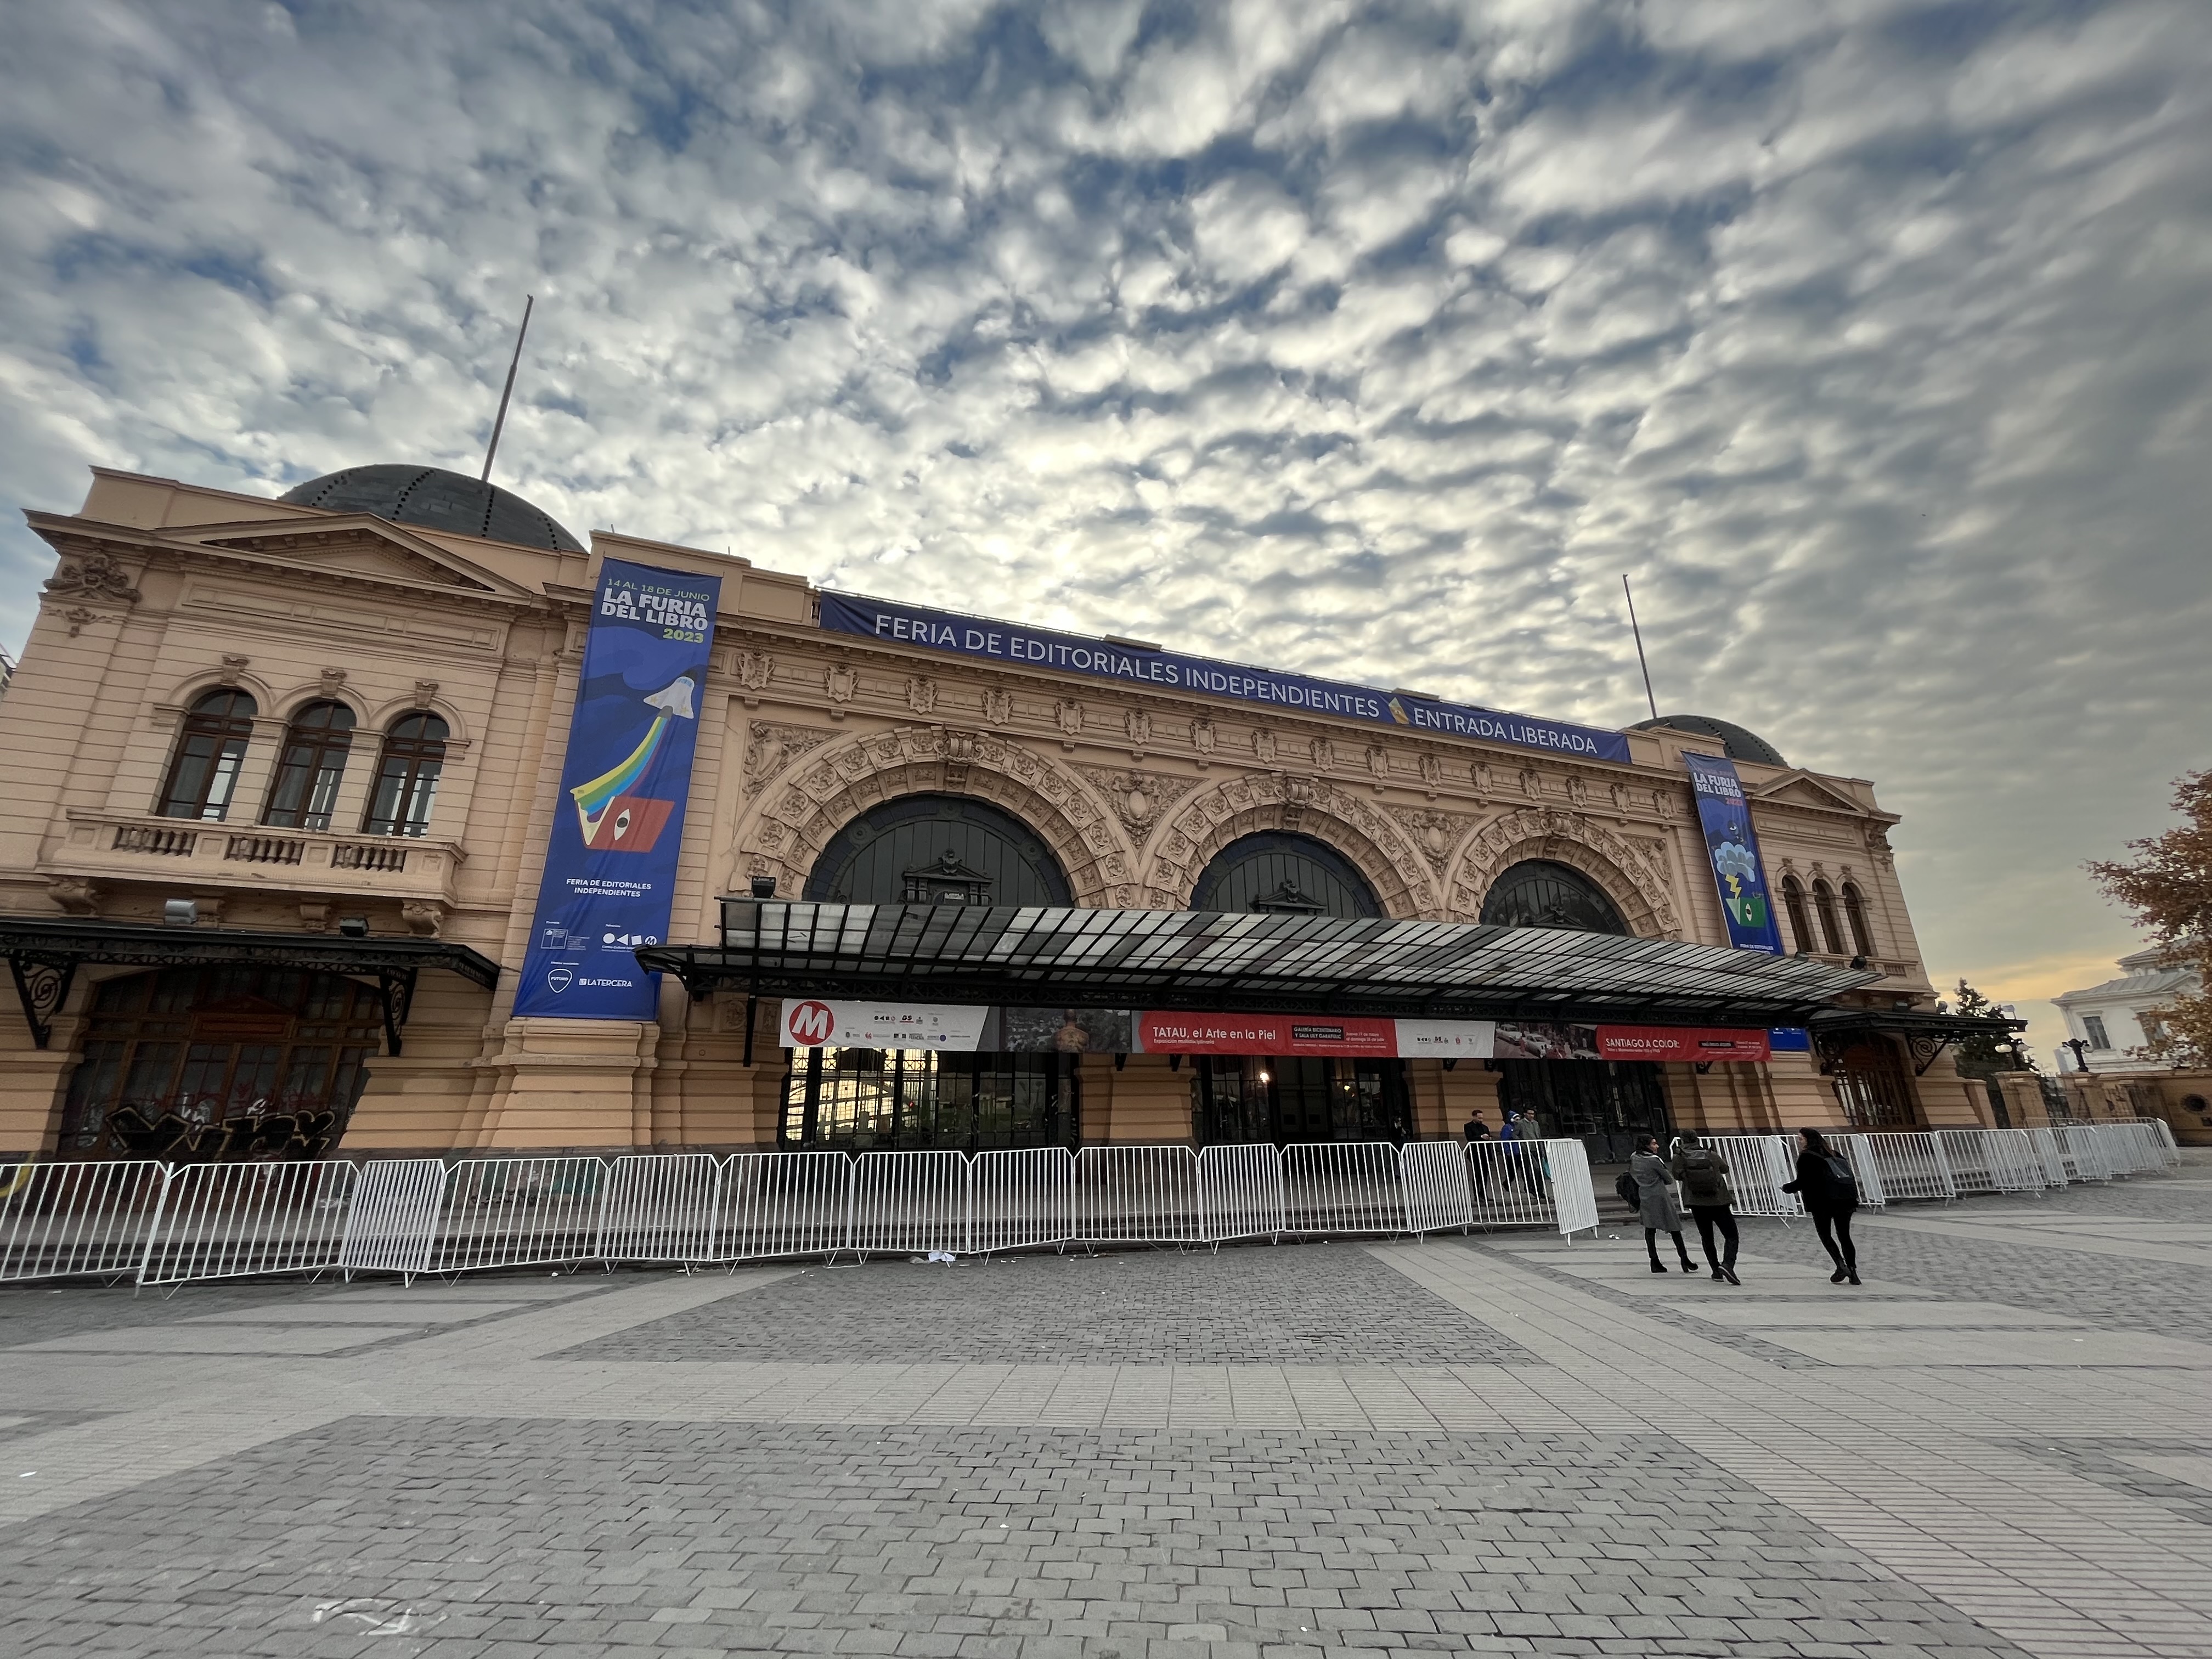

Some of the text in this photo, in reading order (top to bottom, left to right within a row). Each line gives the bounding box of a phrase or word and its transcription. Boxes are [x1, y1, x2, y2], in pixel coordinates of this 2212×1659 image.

[607, 578, 710, 602] 14 AL 18 DE JUNIO
[603, 588, 707, 618] LA FURIA
[601, 602, 708, 631] DEL LIBRO
[663, 628, 704, 644] 2023
[875, 614, 1598, 754] FERIA DE EDITORIALES INDEPENDIENTES ENTRADA LIBERADA
[1693, 772, 1708, 784] LA
[1707, 775, 1739, 789] FURIA
[1696, 783, 1741, 798] DEL LIBRO
[566, 878, 589, 887] FERIA
[601, 881, 652, 890] EDITORIALES
[574, 887, 641, 898] INDEPENDIENTES
[1153, 1026, 1276, 1040] TATAU, el Arte en la Piel
[1606, 1038, 1644, 1048] SANTIAGO
[1646, 1040, 1652, 1048] A
